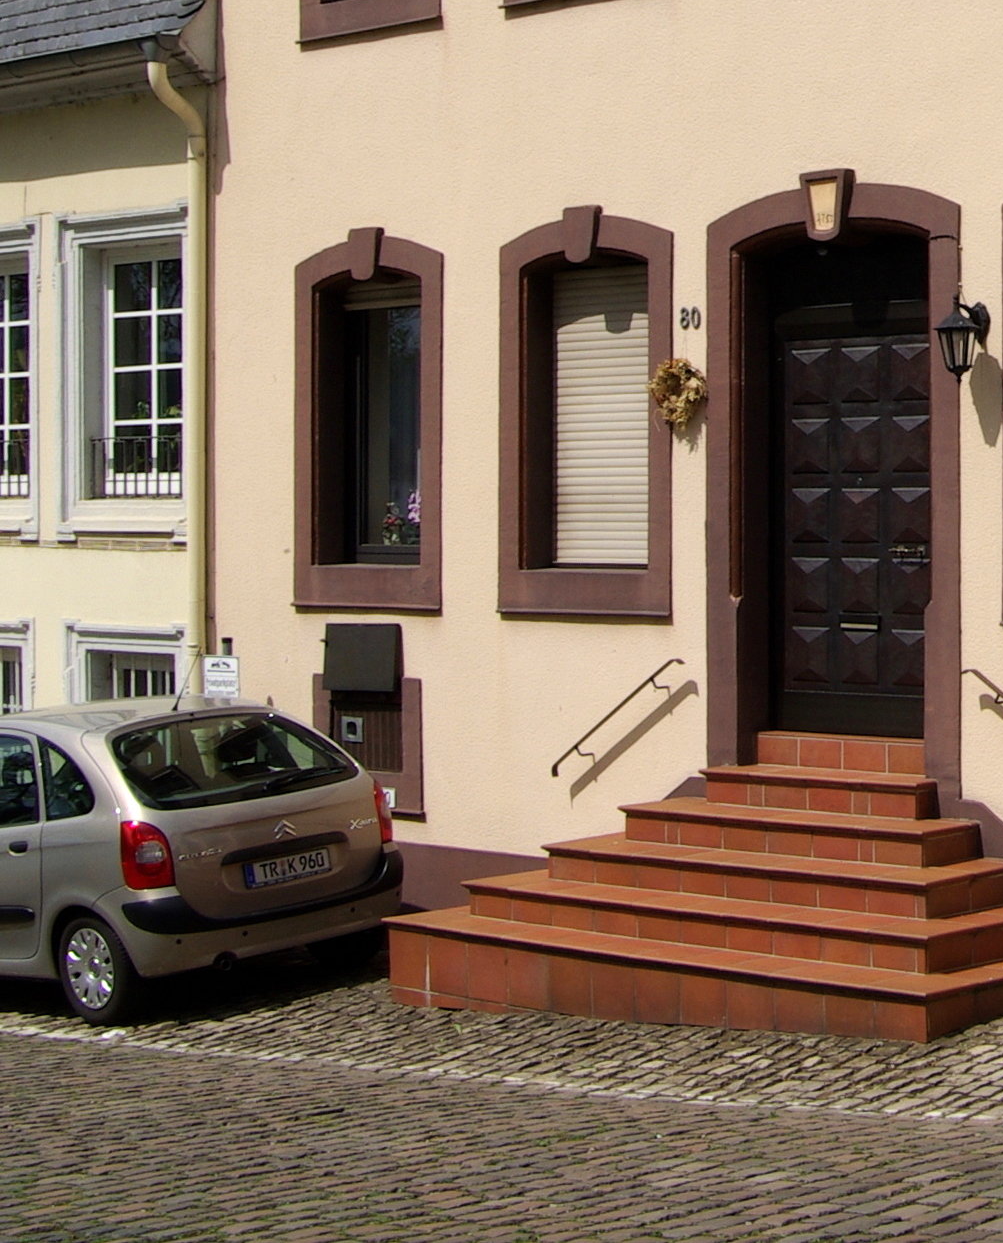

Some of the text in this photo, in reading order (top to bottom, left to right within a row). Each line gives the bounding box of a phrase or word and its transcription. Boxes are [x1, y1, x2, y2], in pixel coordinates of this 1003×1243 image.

[680, 306, 702, 331] 80
[259, 861, 279, 879] TR
[287, 857, 298, 874] K
[299, 851, 326, 871] 960
